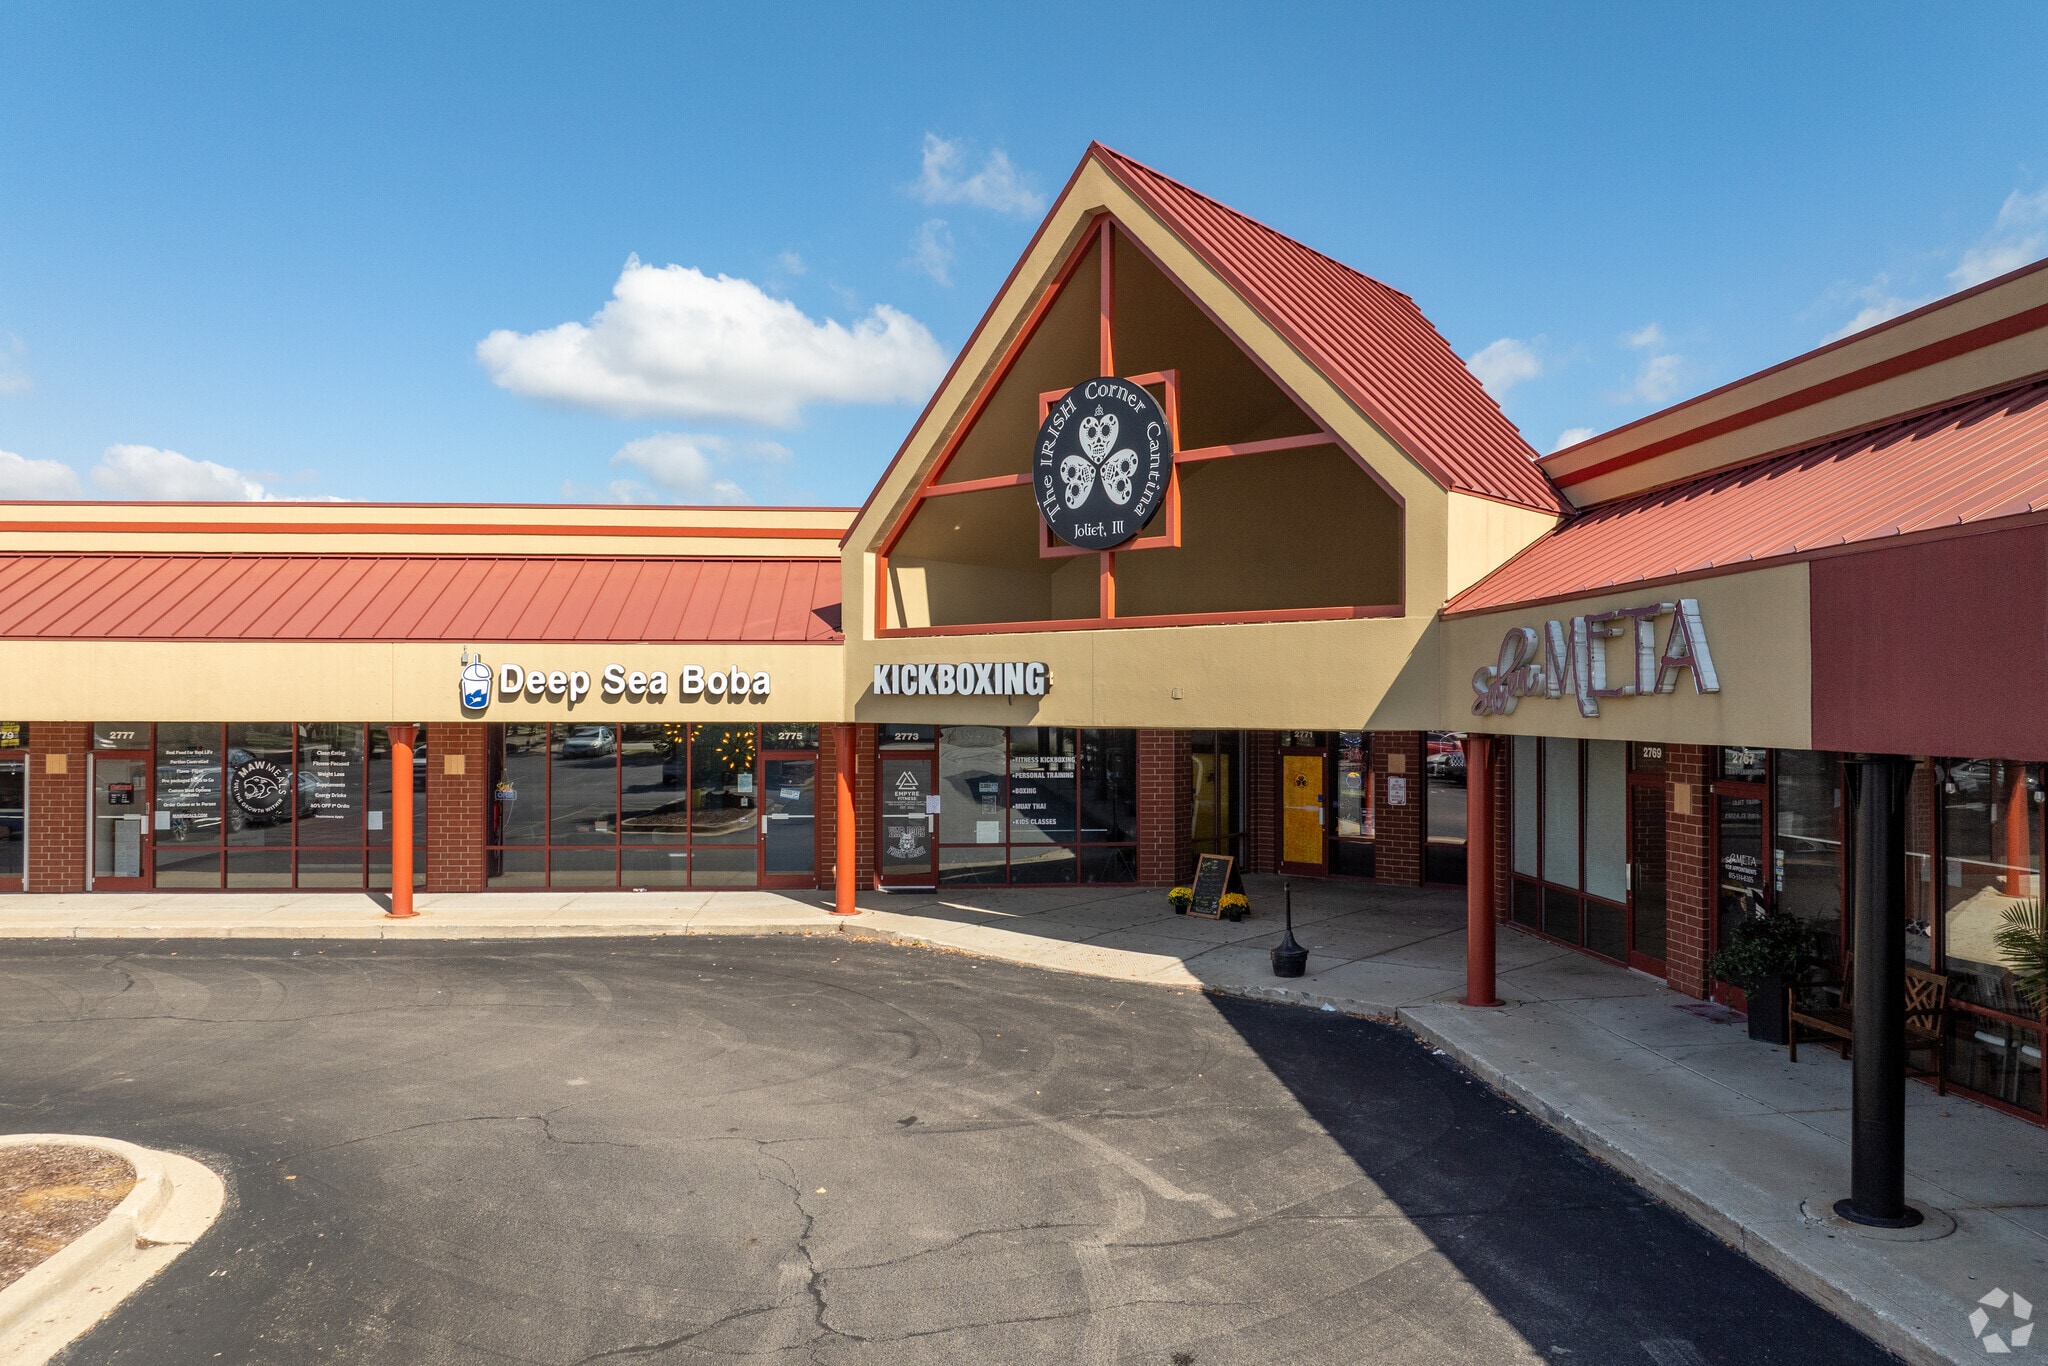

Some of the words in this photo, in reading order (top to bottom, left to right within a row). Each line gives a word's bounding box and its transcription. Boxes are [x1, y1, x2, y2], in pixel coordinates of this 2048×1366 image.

[1084, 381, 1146, 414] Corner
[1040, 396, 1078, 467] IRISH
[1134, 421, 1162, 517] Cantina
[1042, 474, 1062, 523] The
[1074, 521, 1106, 539] Joliet,
[1544, 598, 1720, 718] META
[500, 663, 590, 702] Deep
[604, 663, 668, 695] Sea
[682, 664, 771, 696] Boba
[873, 661, 1048, 696] KICKBOXING
[109, 731, 135, 740] 2777
[778, 732, 803, 740] 2775
[894, 732, 919, 740] 2773
[1643, 746, 1662, 759] 2769
[1732, 752, 1755, 764] 2767
[241, 802, 264, 813] GROWTH
[1736, 854, 1756, 867] META
